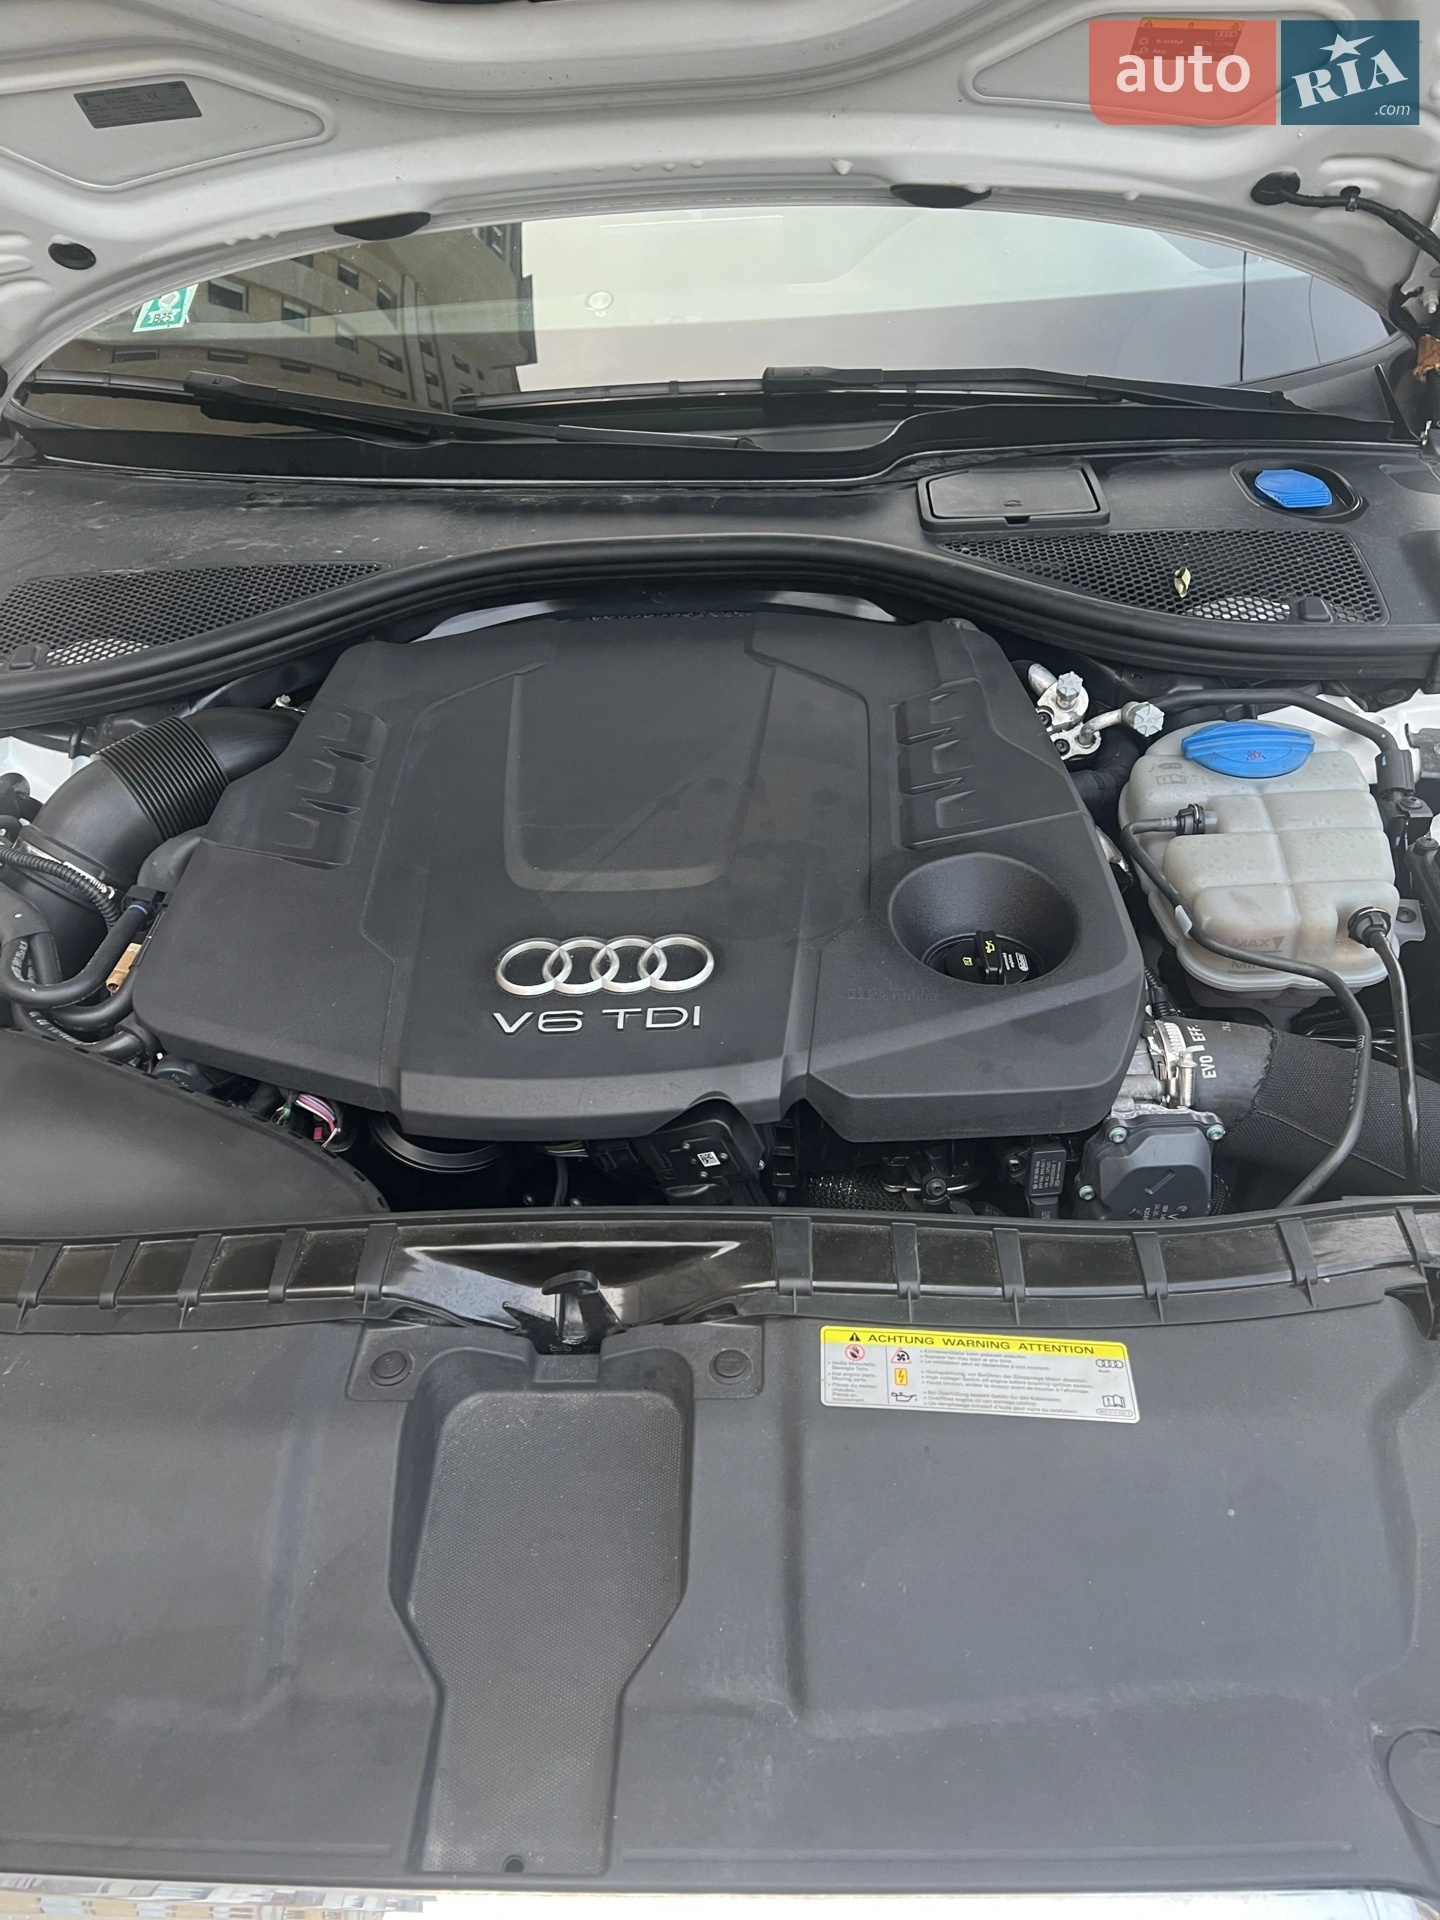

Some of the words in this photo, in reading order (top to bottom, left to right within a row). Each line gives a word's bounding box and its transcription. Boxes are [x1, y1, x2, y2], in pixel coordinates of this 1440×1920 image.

[493, 1010, 584, 1033] V6
[602, 1005, 701, 1030] TDI
[1198, 1055, 1217, 1079] EVO
[867, 1334, 934, 1345] ACHTUNG
[941, 1338, 1011, 1350] WARNING
[1018, 1342, 1095, 1355] ATTENTION
